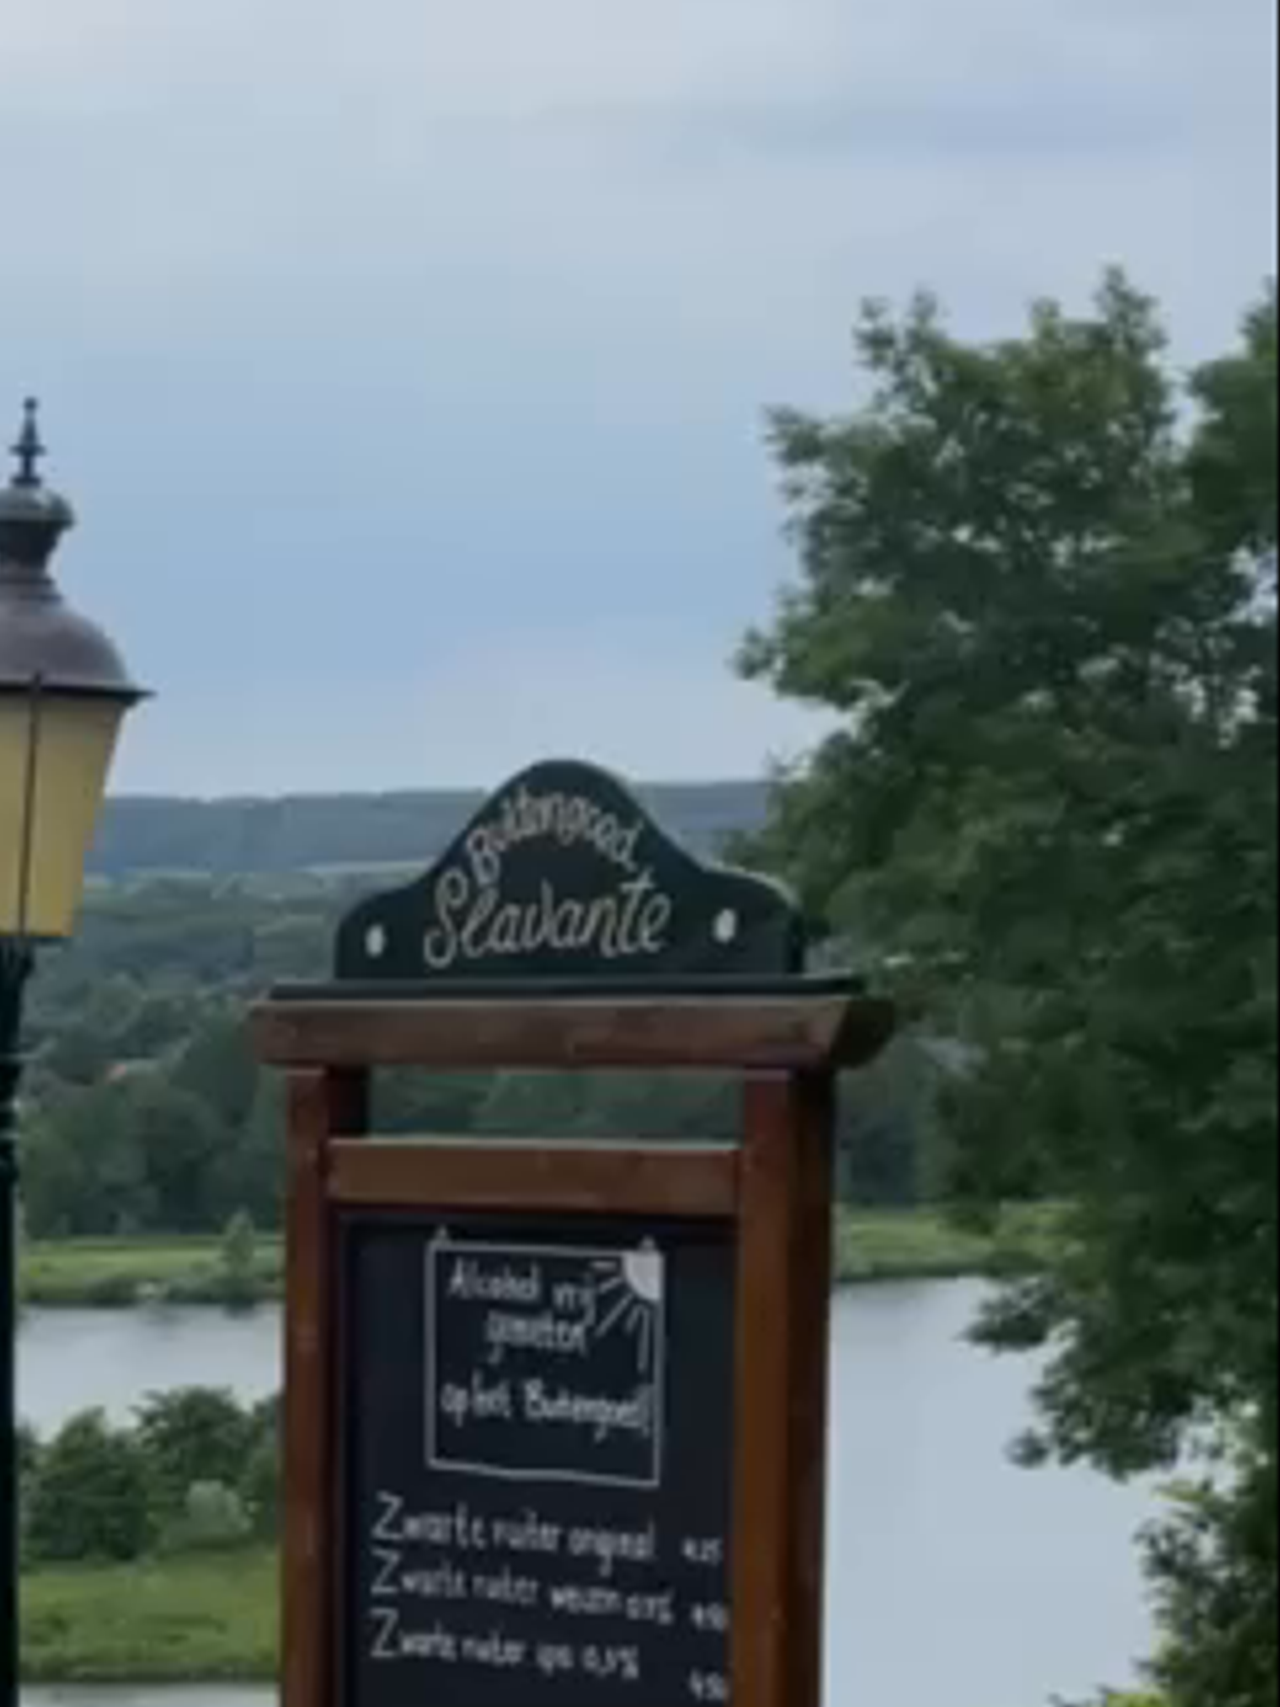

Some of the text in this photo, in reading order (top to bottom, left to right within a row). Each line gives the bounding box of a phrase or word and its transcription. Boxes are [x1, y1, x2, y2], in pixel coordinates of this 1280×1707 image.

[424, 866, 672, 969] Slavante
[372, 1491, 485, 1550] Zwarte
[370, 1545, 468, 1599] Zwarte
[369, 1607, 457, 1661] Zwarte
